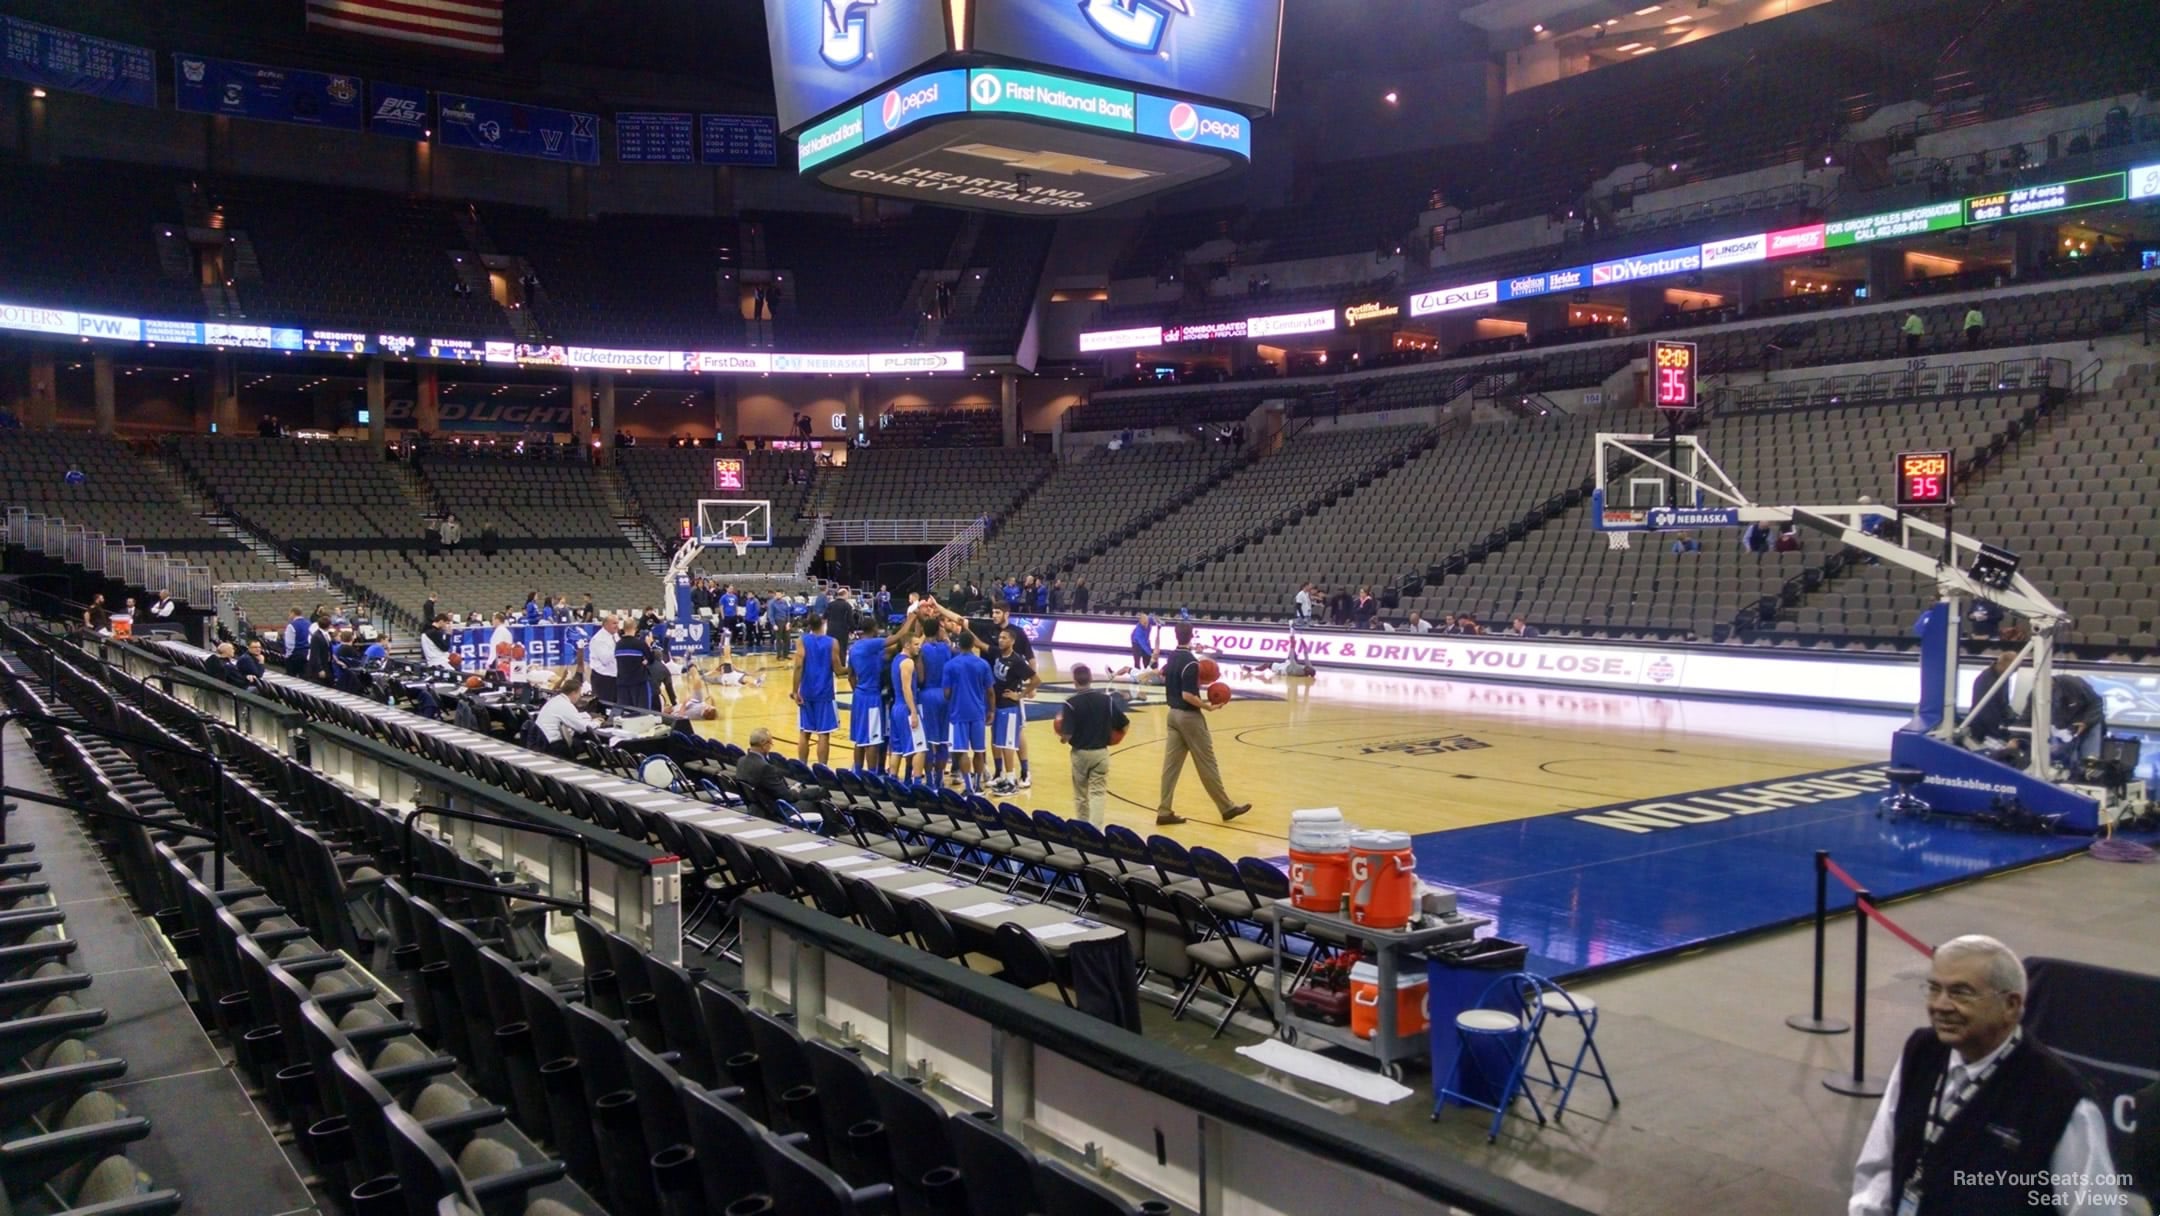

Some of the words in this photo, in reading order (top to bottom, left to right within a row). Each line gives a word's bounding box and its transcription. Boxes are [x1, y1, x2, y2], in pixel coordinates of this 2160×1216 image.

[383, 97, 418, 109] BIG
[902, 83, 938, 114] pepsi
[1006, 82, 1036, 102] First
[1036, 87, 1097, 114] National
[1098, 100, 1133, 120] Bank
[376, 106, 426, 120] EAST
[810, 126, 842, 152] National
[842, 118, 862, 140] Bank
[1200, 118, 1240, 140] pepsi
[850, 168, 962, 192] CHEVY
[960, 186, 1093, 208] DEALERS
[903, 168, 1085, 200] HEARTLAND
[1971, 194, 2006, 210] NCAAB
[2009, 190, 2028, 204] Air
[2028, 184, 2066, 199] Force
[2009, 197, 2065, 214] Colorado
[1826, 223, 1843, 236] FOR
[1844, 218, 1873, 232] GROUP
[1874, 213, 1900, 226] SALES
[1902, 202, 1961, 222] INFORMATION
[1854, 229, 1876, 242] CALL
[1715, 240, 1759, 256] LINDSAY
[1612, 252, 1700, 281] DiVentures
[1510, 276, 1545, 291] Creighton
[1550, 272, 1580, 287] Heider
[1436, 288, 1489, 308] LEXUS
[0, 306, 64, 327] OTER'S
[1272, 316, 1328, 331] CenturyLink
[80, 317, 122, 336] PVW
[1182, 322, 1247, 335] CONSOLIDATED
[313, 331, 366, 342] CREIGHTON
[380, 335, 415, 347] 52:04
[354, 342, 364, 353] 0
[430, 346, 439, 357] 0
[573, 349, 664, 366] ticketmaster
[807, 358, 866, 370] NEBRASKA
[884, 357, 936, 367] PLAINS
[1906, 358, 1927, 371] 105
[1662, 368, 1686, 401] 35
[1585, 394, 1600, 403] 104
[386, 399, 467, 421] BD
[468, 402, 573, 424] LIGHT
[1912, 477, 1938, 497] 35
[1677, 514, 1728, 524] NEBRASKA
[1212, 634, 1253, 650] YOU
[1340, 642, 1356, 657] &
[1366, 644, 1455, 668] DRIVE,
[1466, 650, 1528, 669] YOU
[1537, 654, 1633, 676] LOSE.
[1292, 864, 1304, 882] G
[1352, 856, 1368, 880] G
[2112, 1094, 2137, 1134] C
